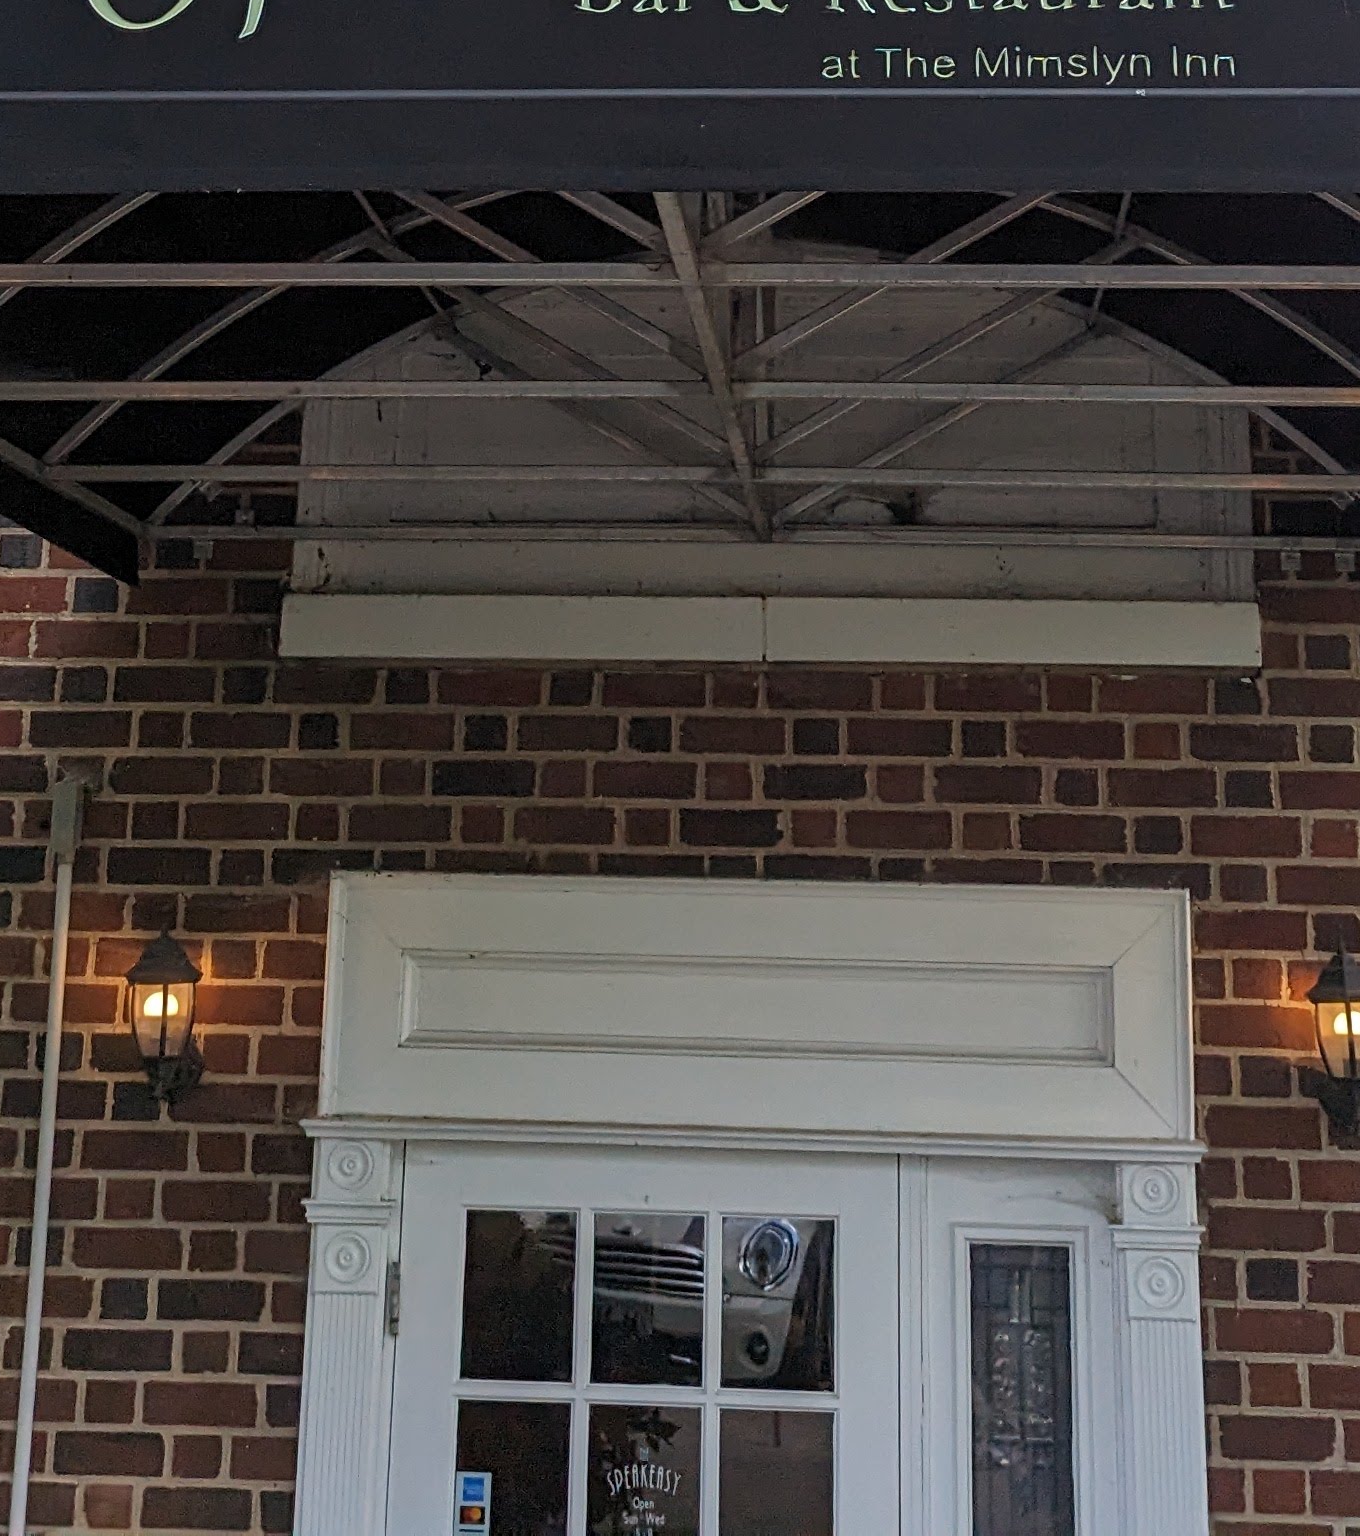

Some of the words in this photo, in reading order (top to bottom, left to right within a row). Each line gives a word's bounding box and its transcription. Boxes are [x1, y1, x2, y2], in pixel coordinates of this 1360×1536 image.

[821, 49, 861, 79] at
[874, 47, 956, 79] The
[975, 45, 1151, 86] Mimslyn
[1172, 45, 1236, 78] Inn
[606, 1464, 682, 1496] SPEAKEASY
[633, 1496, 655, 1512] Open
